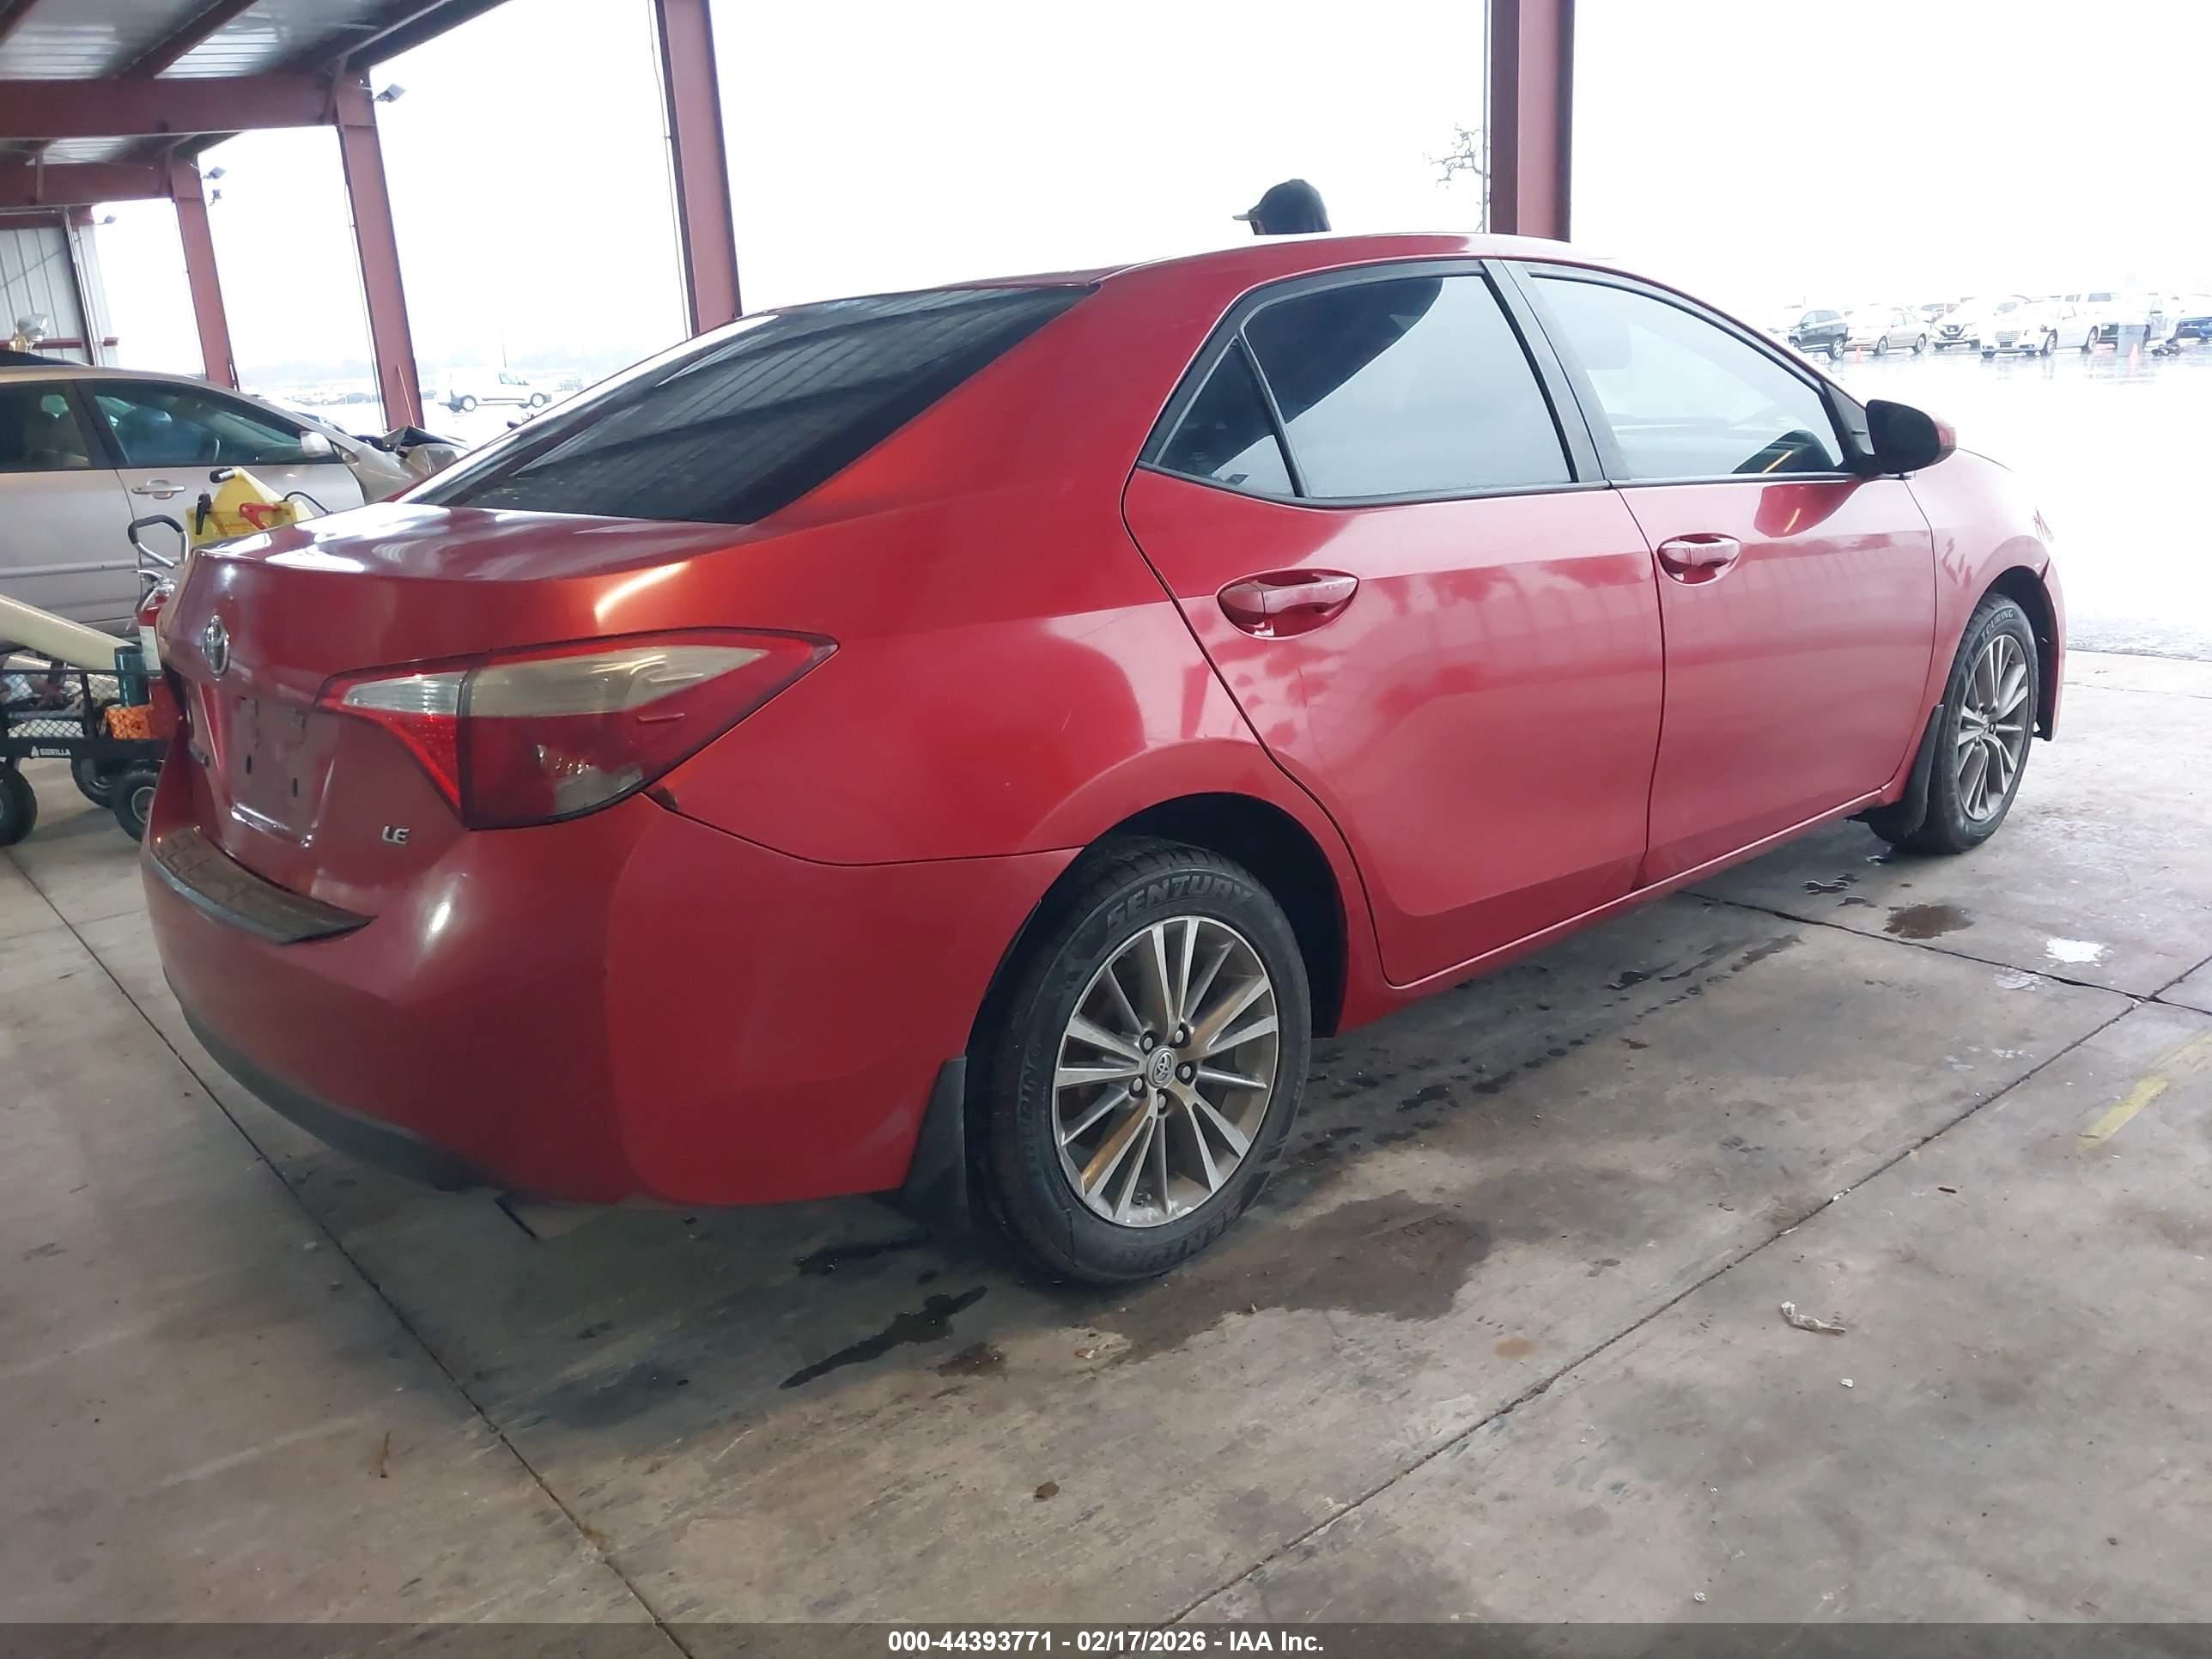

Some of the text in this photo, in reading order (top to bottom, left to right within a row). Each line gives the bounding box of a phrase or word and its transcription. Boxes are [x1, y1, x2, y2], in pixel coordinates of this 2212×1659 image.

[1981, 609, 2014, 643] TOURING
[381, 825, 410, 845] LE
[1107, 874, 1254, 928] SENTURY
